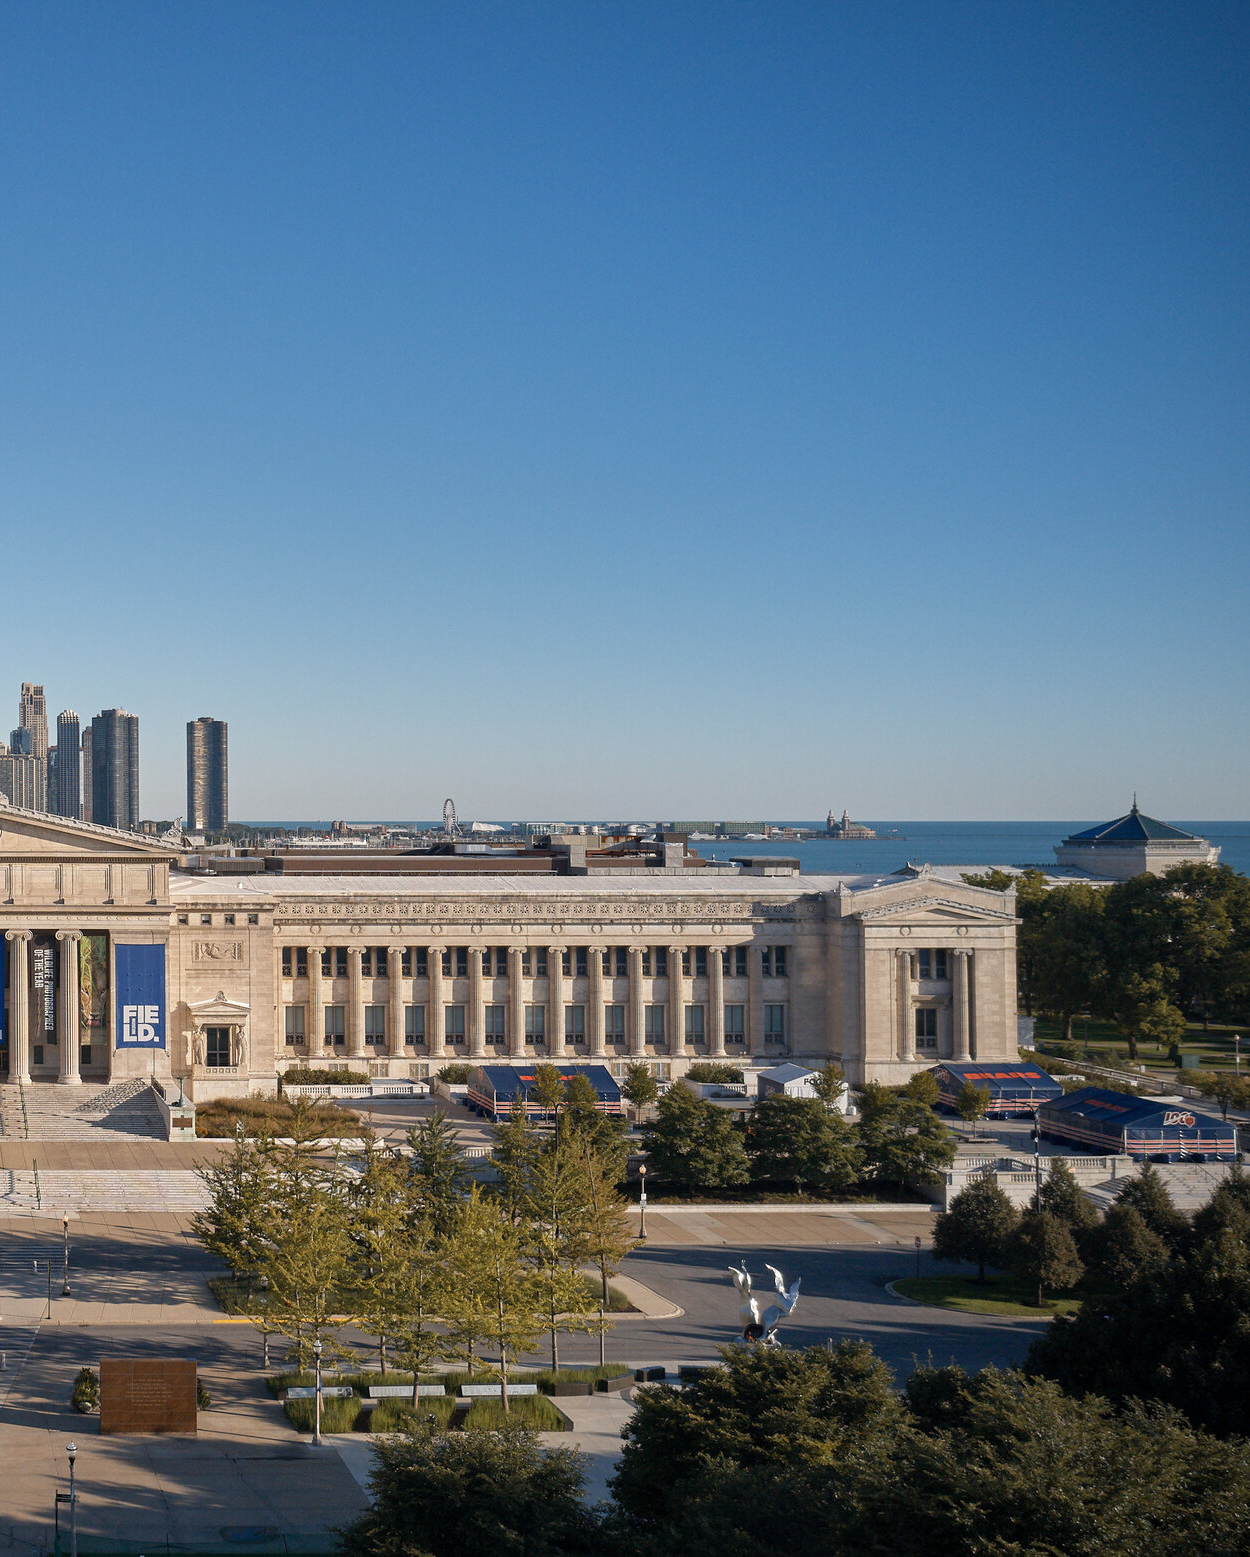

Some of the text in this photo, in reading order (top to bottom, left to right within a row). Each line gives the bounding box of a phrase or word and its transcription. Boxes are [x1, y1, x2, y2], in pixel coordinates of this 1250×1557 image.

[34, 949, 44, 988] OF THE YEAR
[44, 949, 54, 1031] WILDLIFE PHOTOGRAPHER
